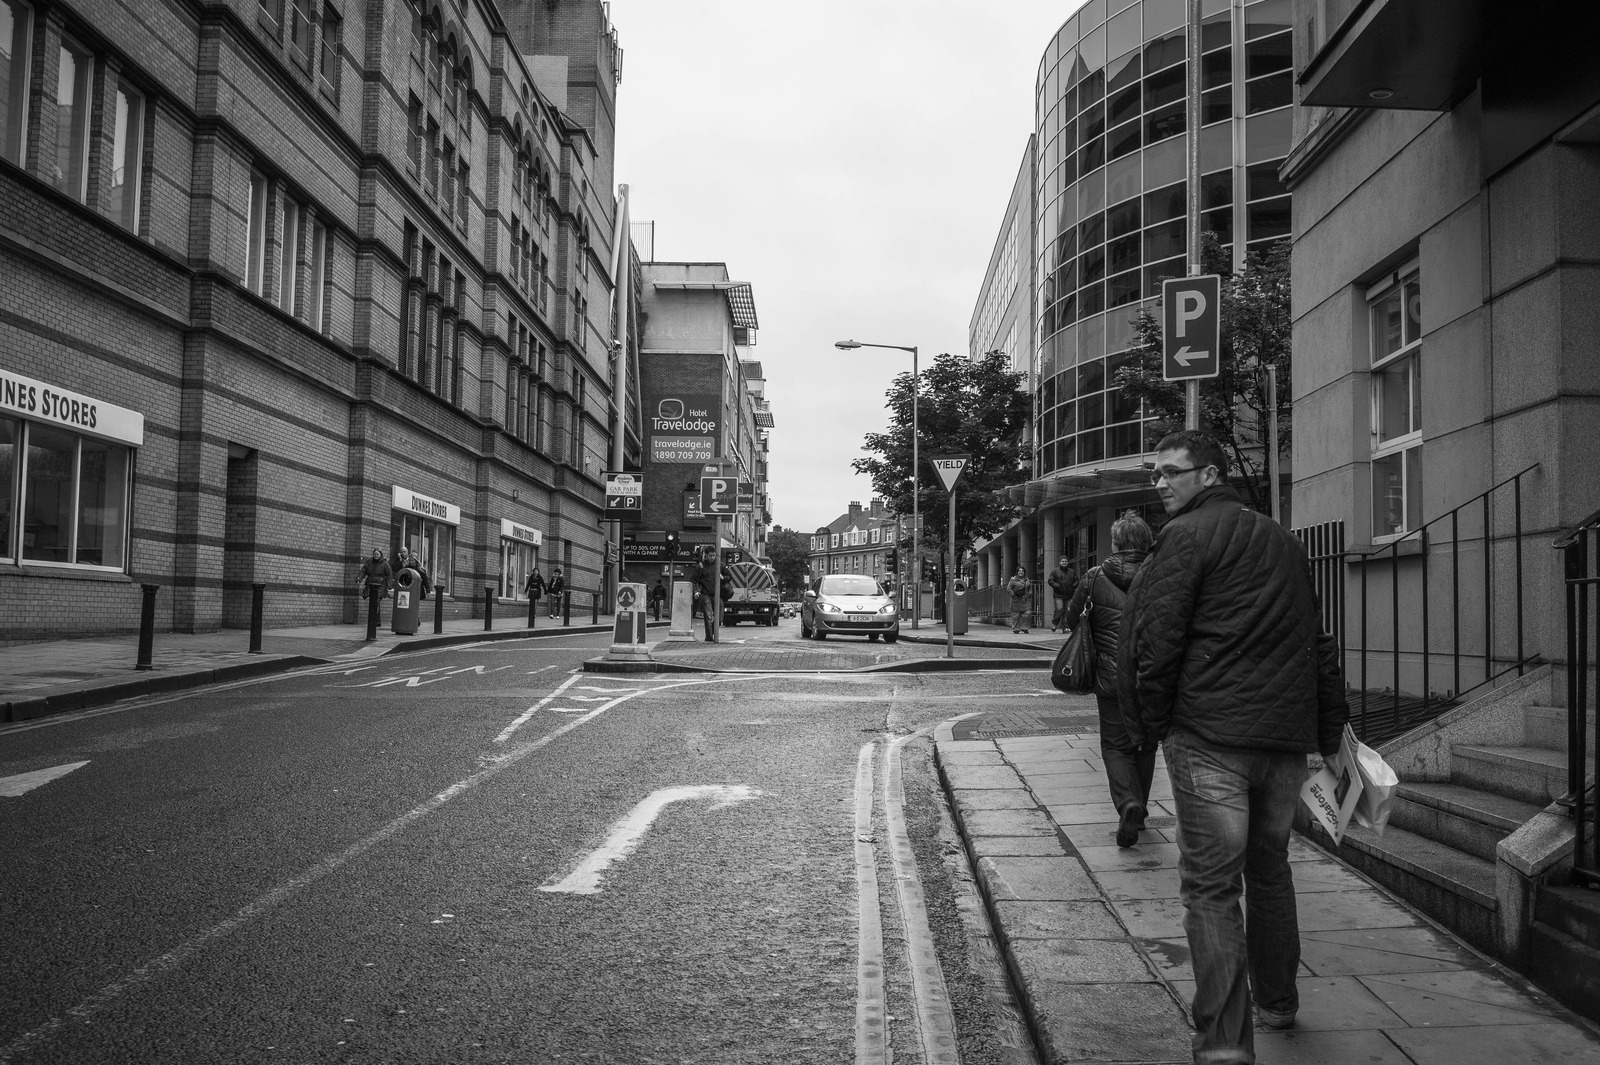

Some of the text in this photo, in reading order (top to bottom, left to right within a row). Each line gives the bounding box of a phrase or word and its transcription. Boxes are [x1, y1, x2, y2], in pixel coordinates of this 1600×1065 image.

[1176, 290, 1207, 338] P
[42, 389, 97, 429] STORES
[689, 409, 708, 417] Hotel
[651, 417, 716, 433] Travelodge
[654, 439, 712, 450] travelodge.ie
[654, 451, 711, 460] 1890 709 709
[936, 460, 963, 469] YIELD
[711, 479, 727, 500] P
[411, 495, 447, 519] DUNNES STORES
[626, 497, 634, 507] P
[1309, 785, 1340, 830] vodafone
